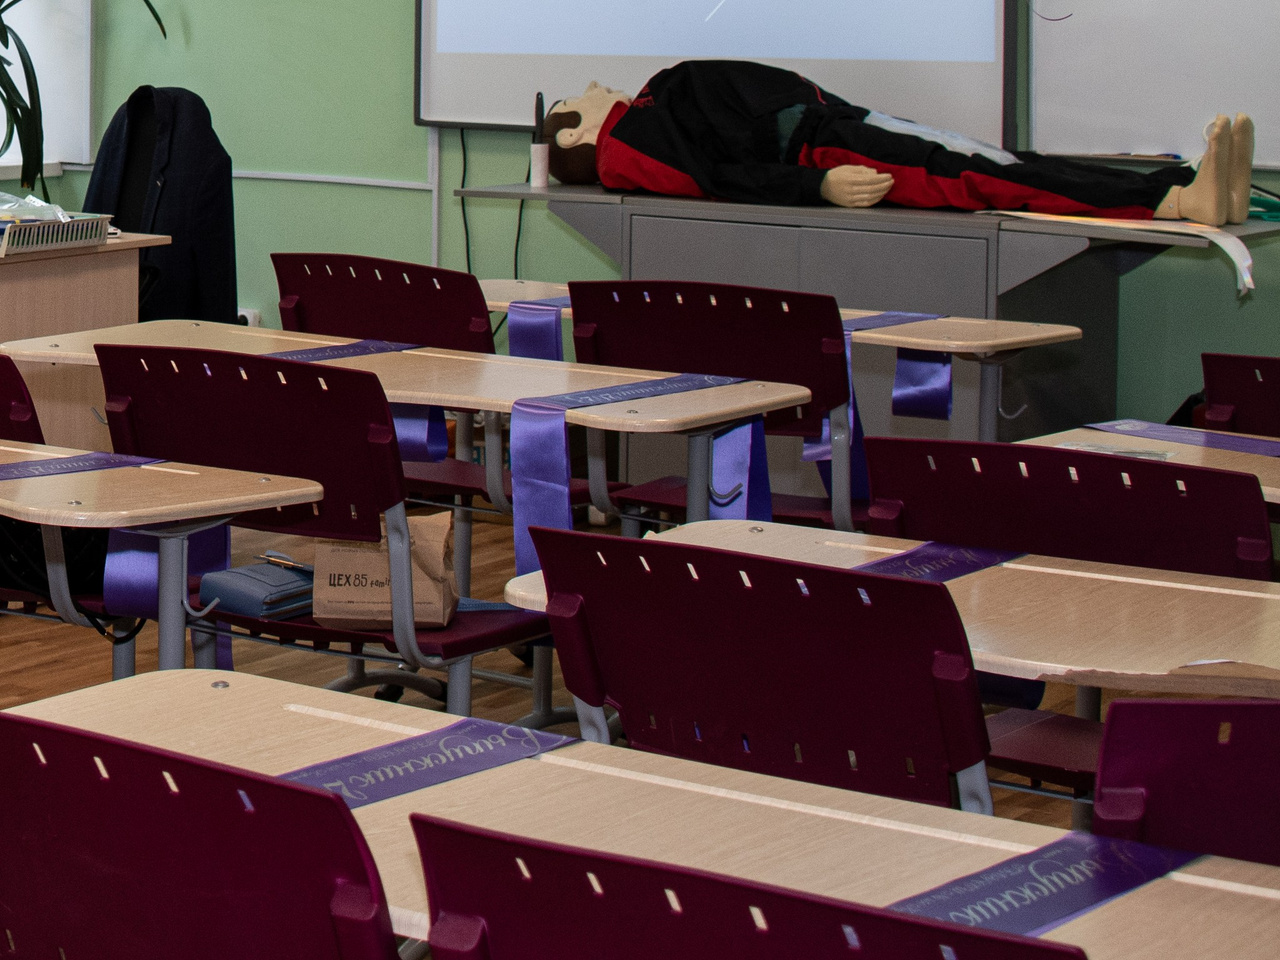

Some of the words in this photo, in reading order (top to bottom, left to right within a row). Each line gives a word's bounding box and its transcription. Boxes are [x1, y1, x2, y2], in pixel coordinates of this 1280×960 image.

[329, 573, 352, 587] ЦЕХ
[353, 573, 368, 587] 85
[370, 577, 391, 588] famil
